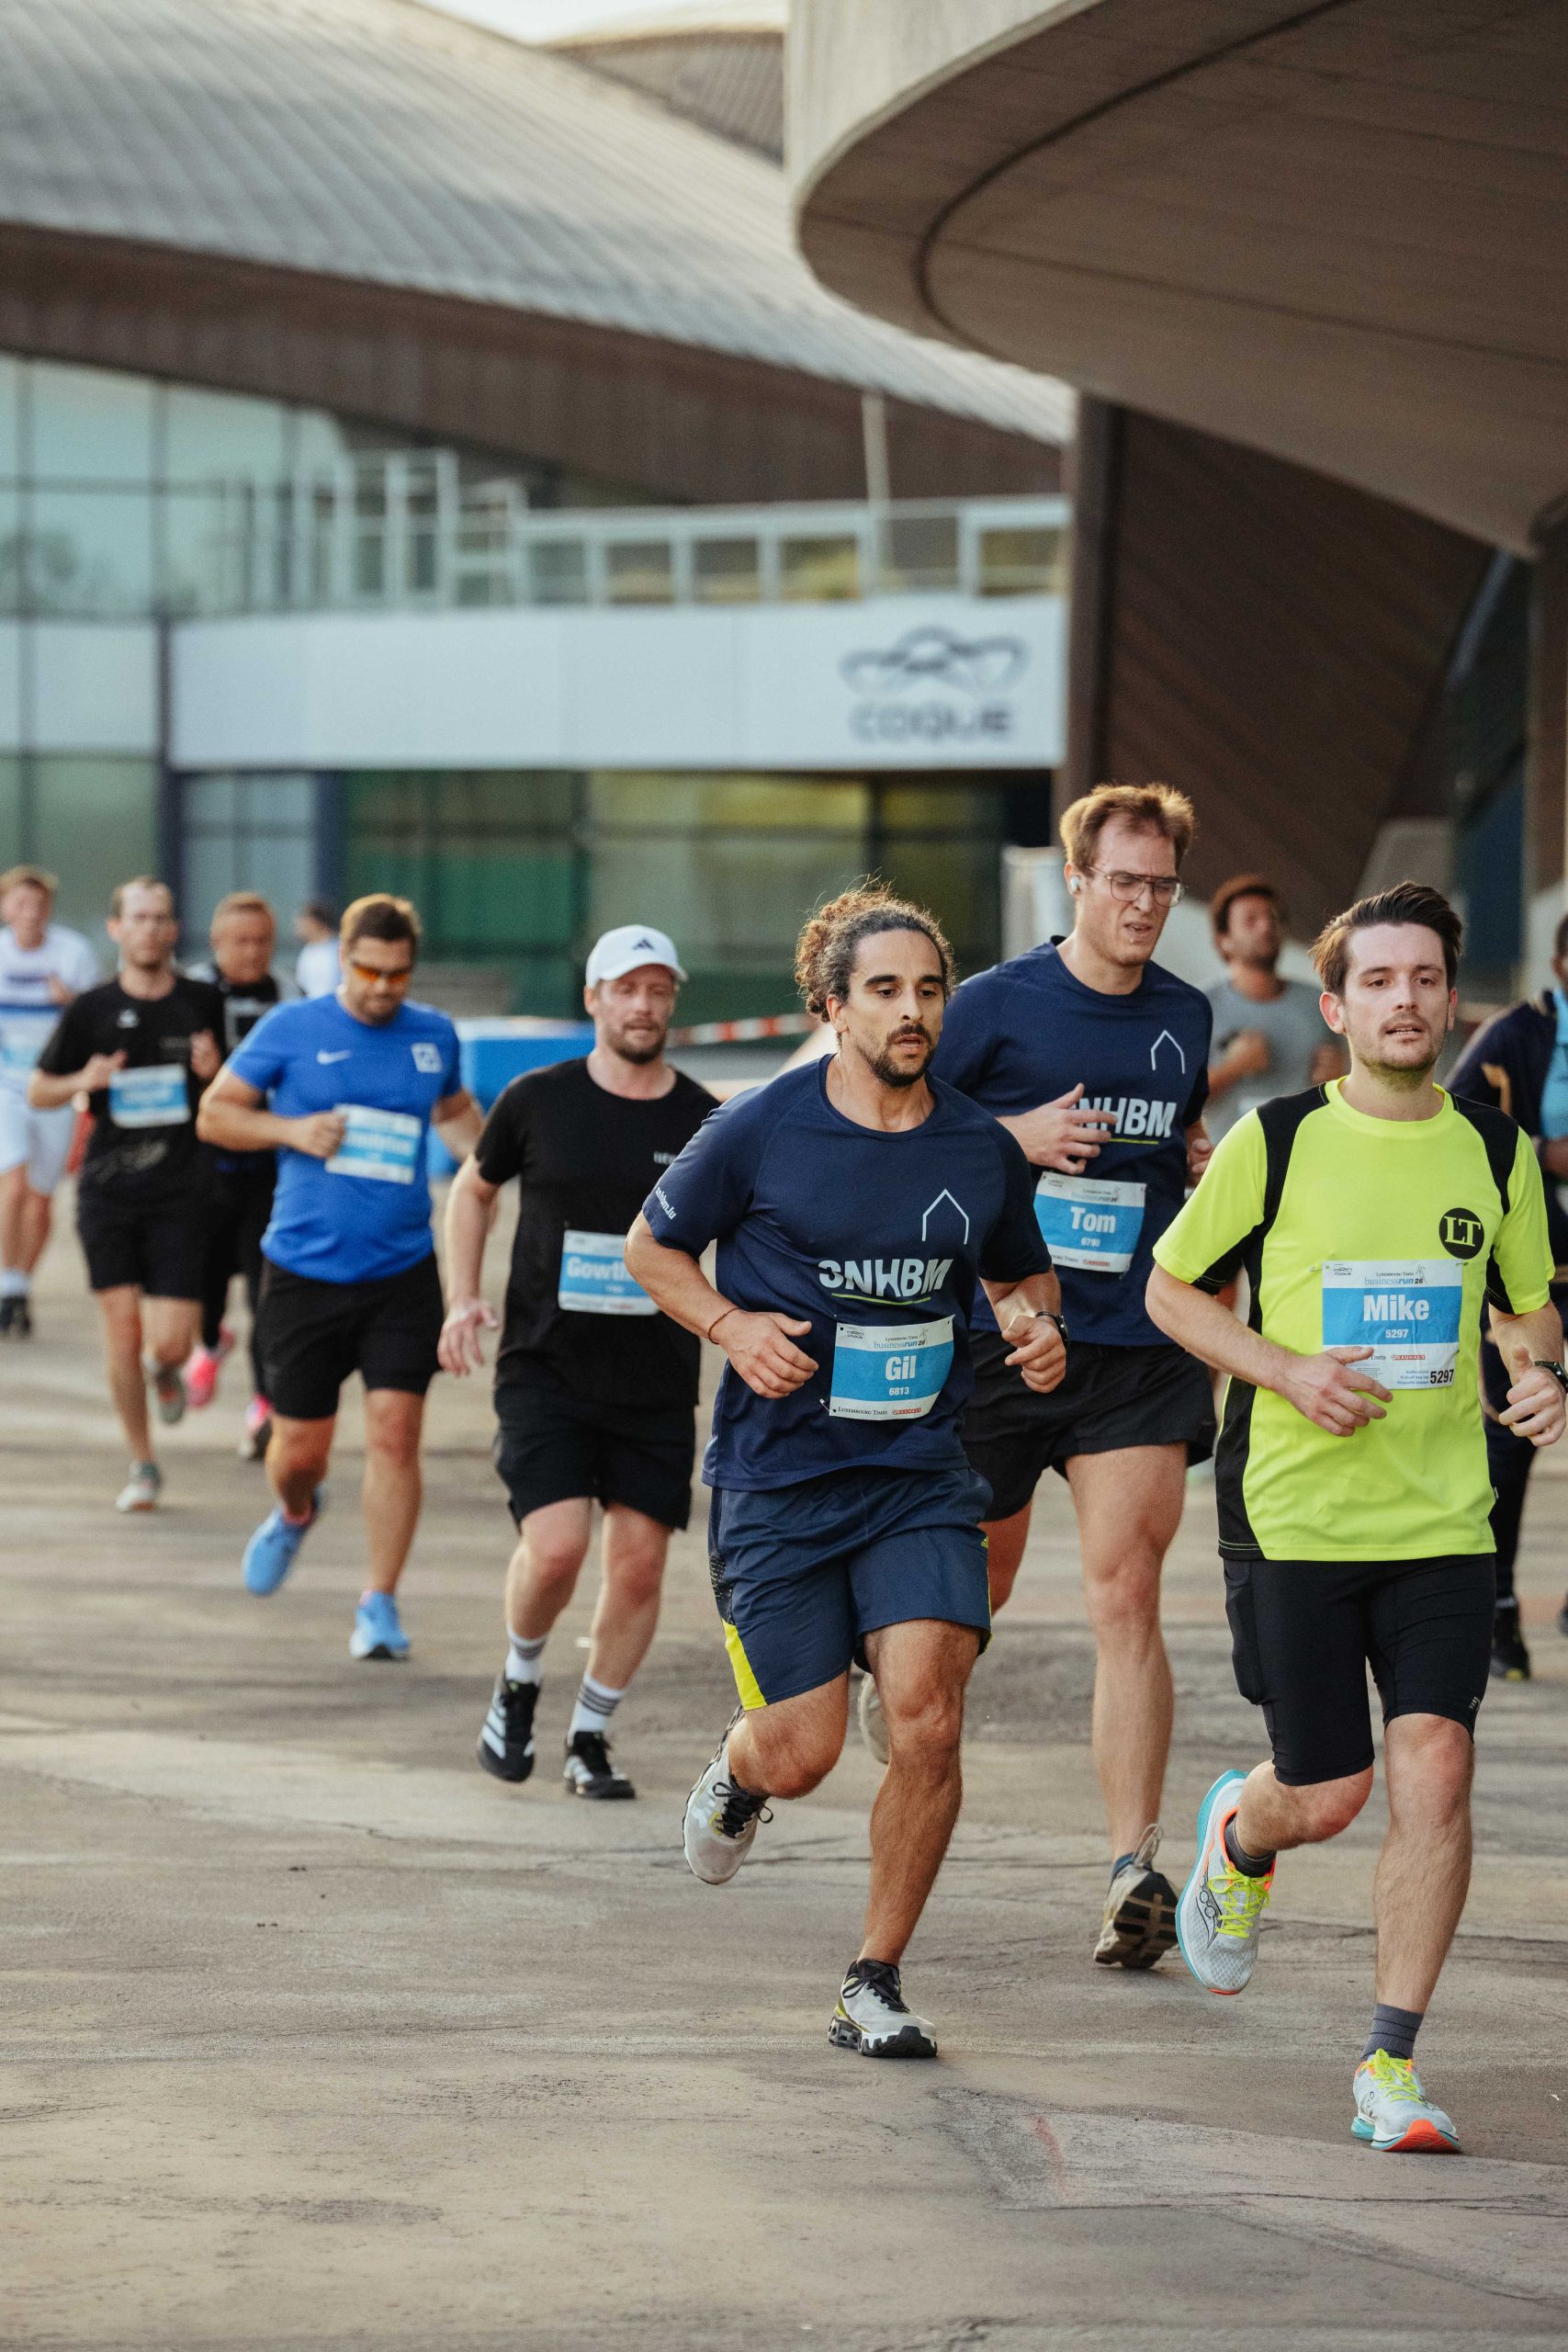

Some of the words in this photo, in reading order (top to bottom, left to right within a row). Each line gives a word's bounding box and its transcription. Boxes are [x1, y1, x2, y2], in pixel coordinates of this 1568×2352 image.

[849, 704, 1014, 742] COQUE
[1069, 1096, 1177, 1138] NHBM
[1070, 1205, 1116, 1234] Tom
[1444, 1216, 1482, 1247] LT
[1363, 1294, 1429, 1321] Mike
[1384, 1329, 1409, 1339] 5297
[885, 1355, 917, 1381] Gil
[1429, 1369, 1455, 1385] 5297
[888, 1386, 910, 1396] 6813
